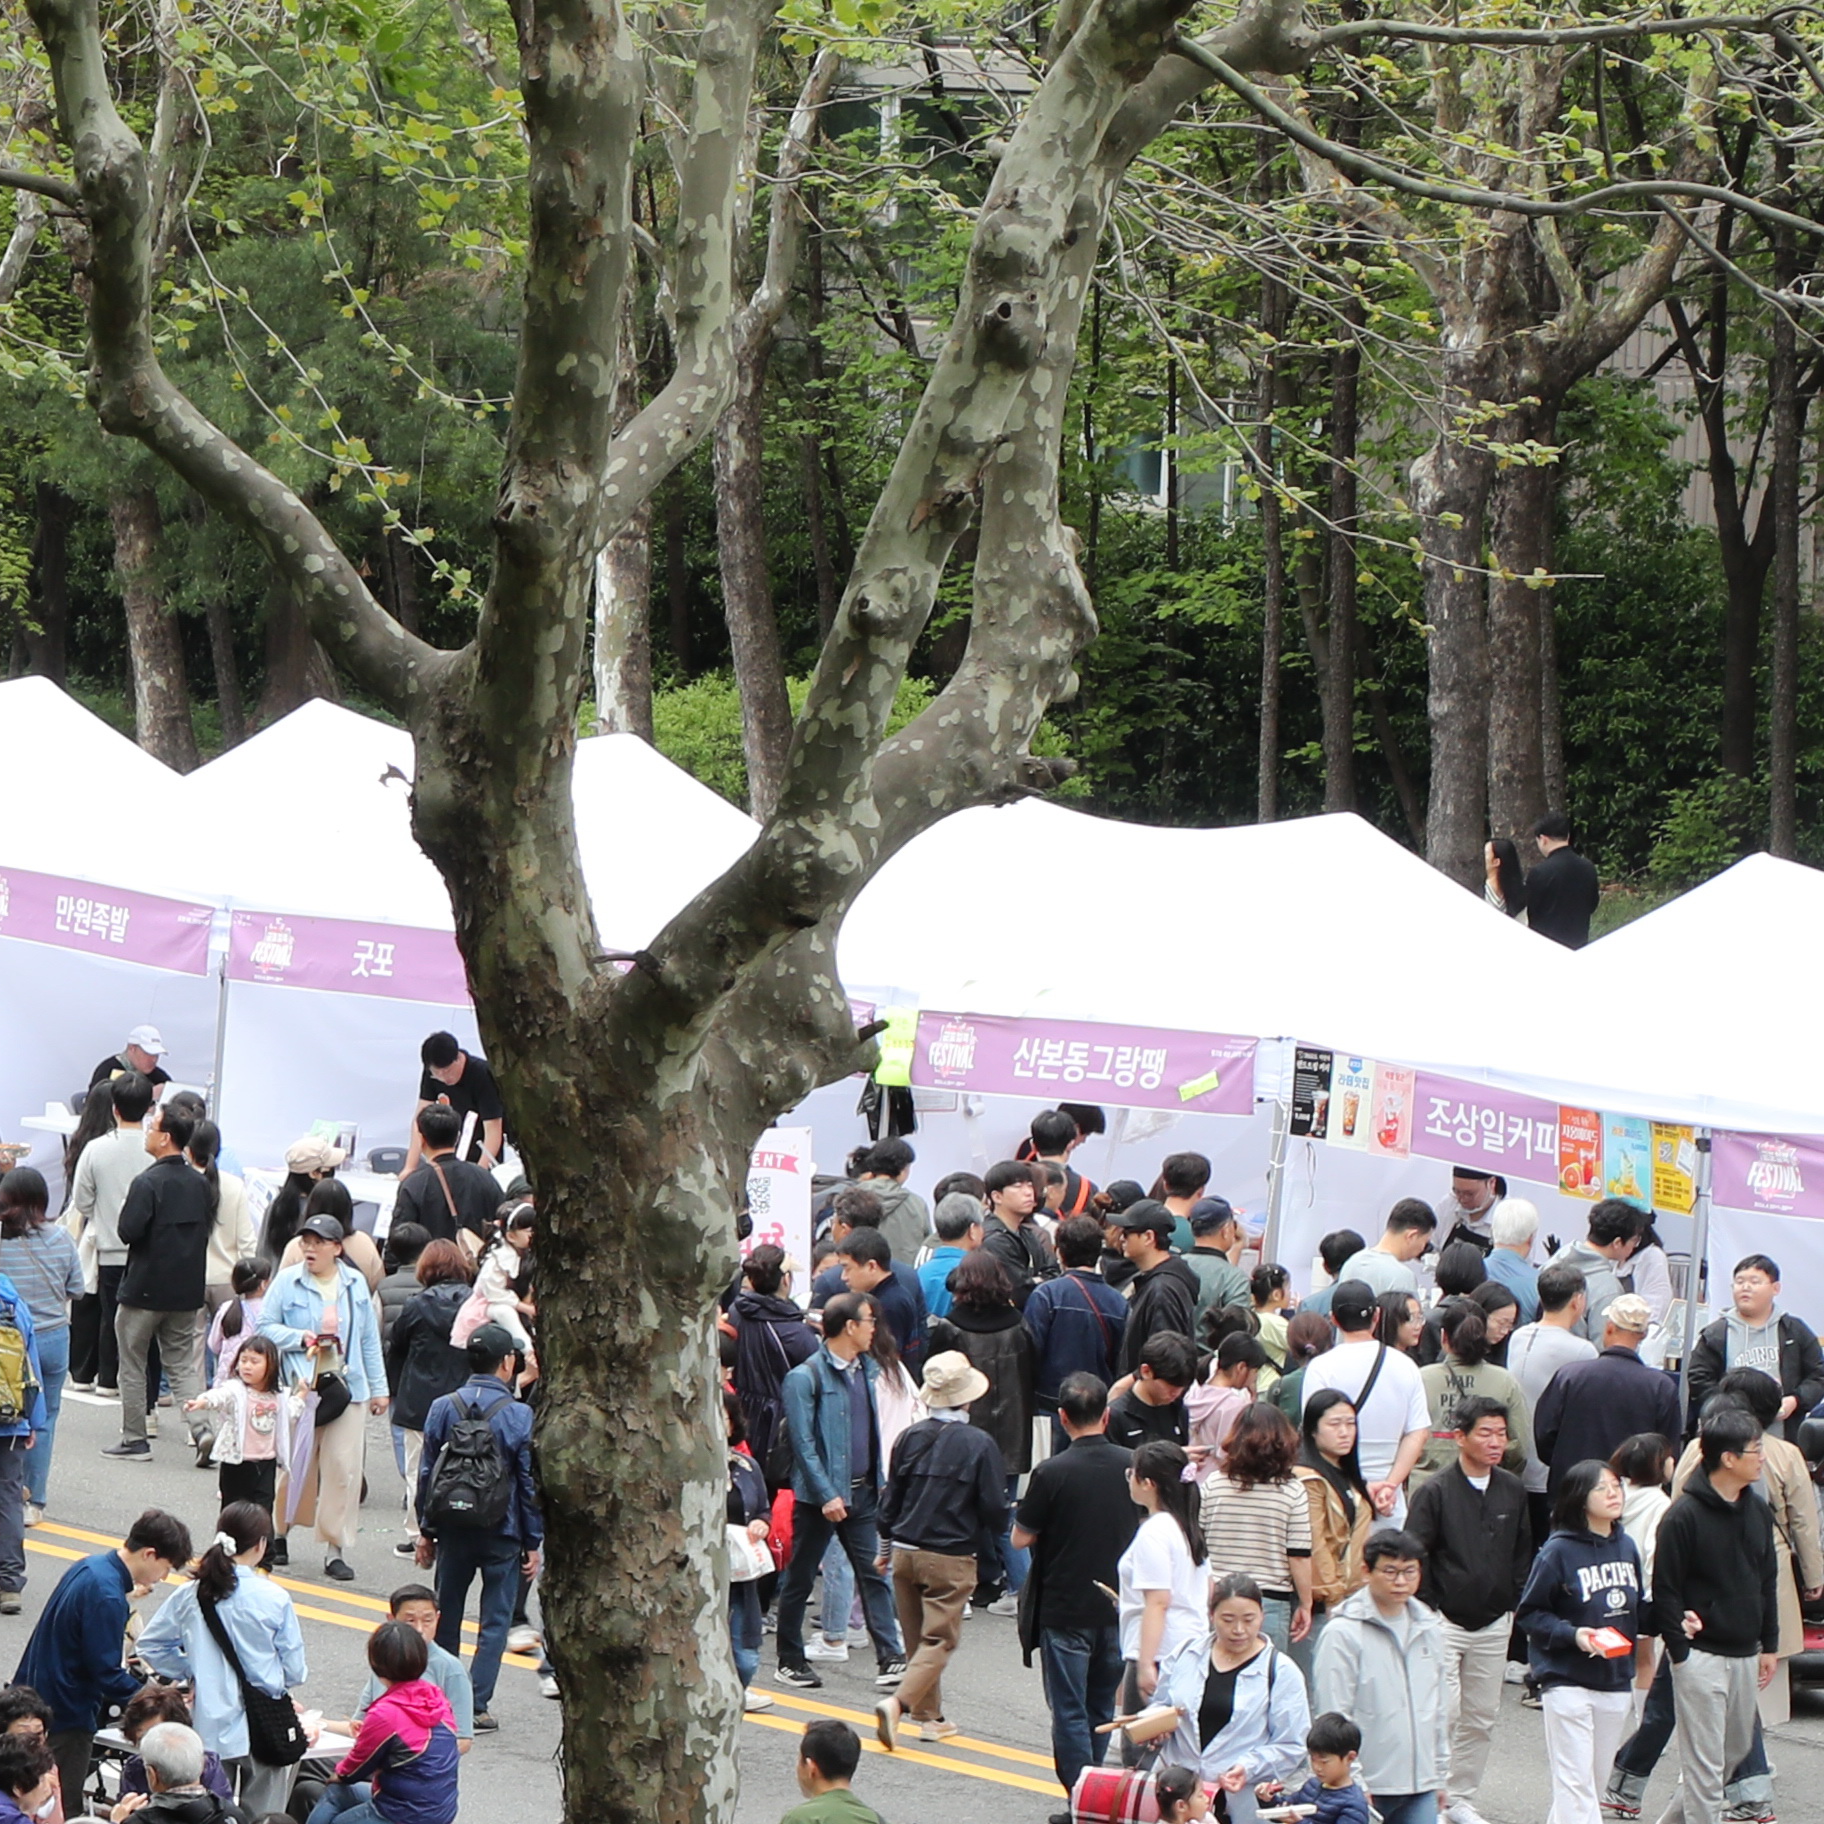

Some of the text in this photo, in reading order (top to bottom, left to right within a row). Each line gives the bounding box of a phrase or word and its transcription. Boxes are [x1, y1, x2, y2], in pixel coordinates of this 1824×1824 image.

[55, 894, 130, 944] 만원족발
[351, 940, 396, 978] 굿포
[928, 1041, 974, 1069] FESTIVAL
[1013, 1037, 1168, 1090] 산본동그랑땡
[1425, 1097, 1559, 1166] 조상일커피
[752, 1152, 785, 1167] ENT
[1747, 1161, 1805, 1192] FESTIVAL
